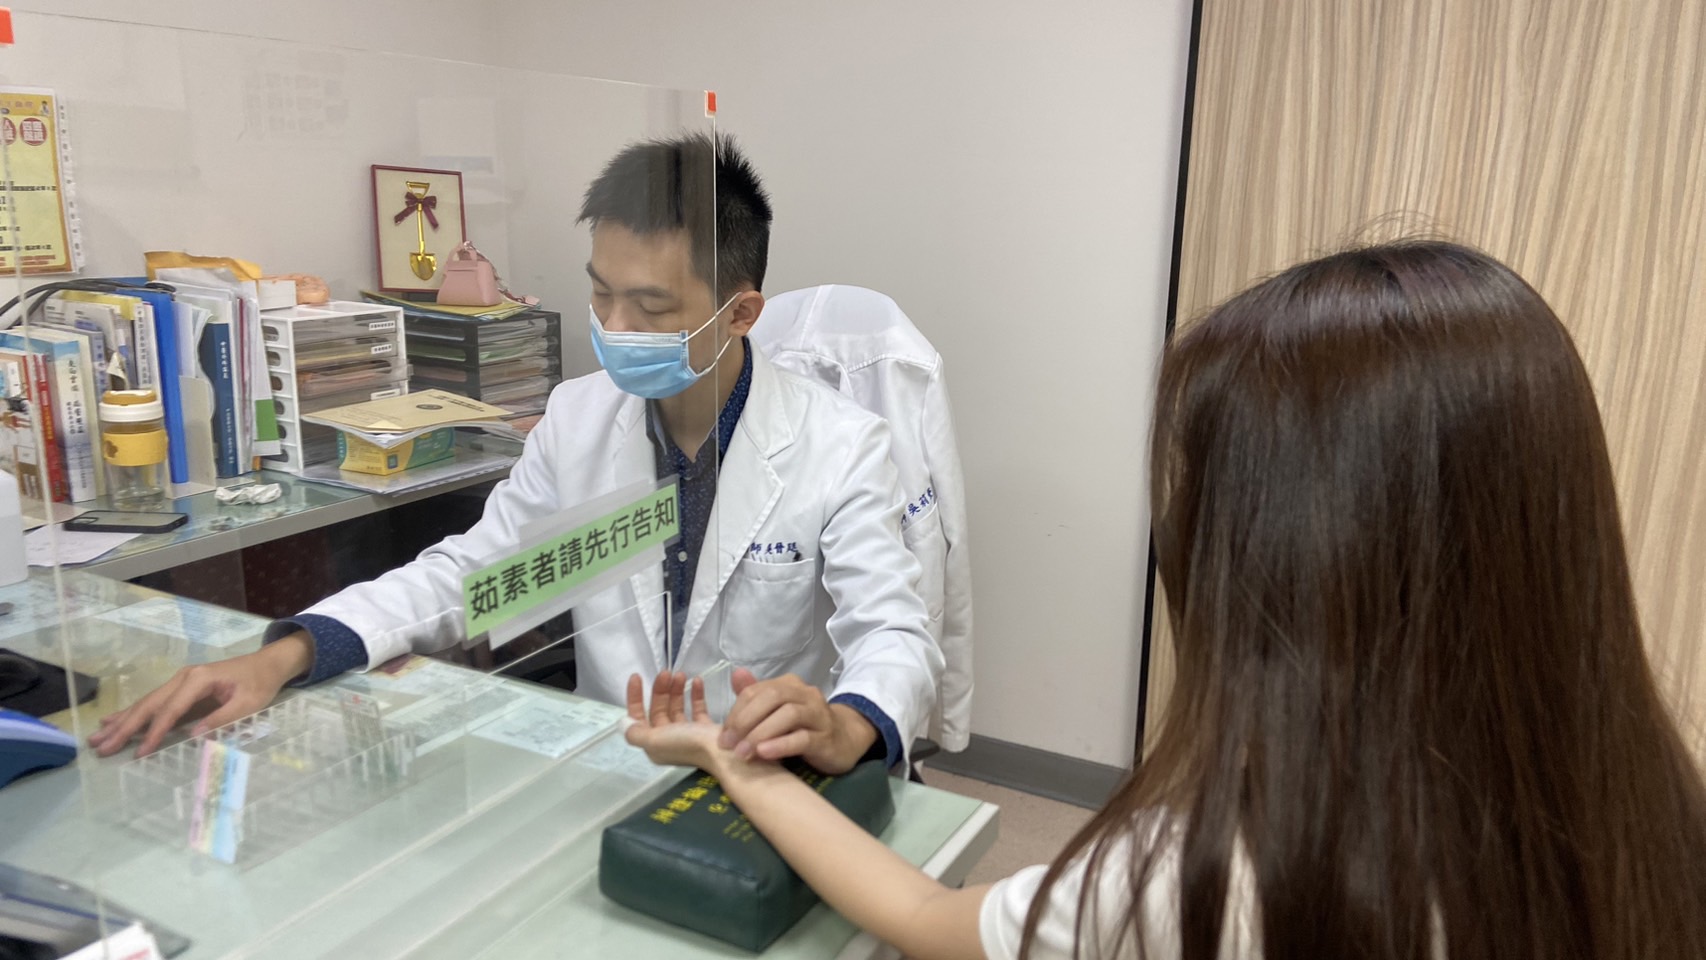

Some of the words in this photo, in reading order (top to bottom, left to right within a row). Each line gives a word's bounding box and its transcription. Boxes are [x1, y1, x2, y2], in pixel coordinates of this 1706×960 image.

[469, 497, 675, 620] 茹素者請先行告知
